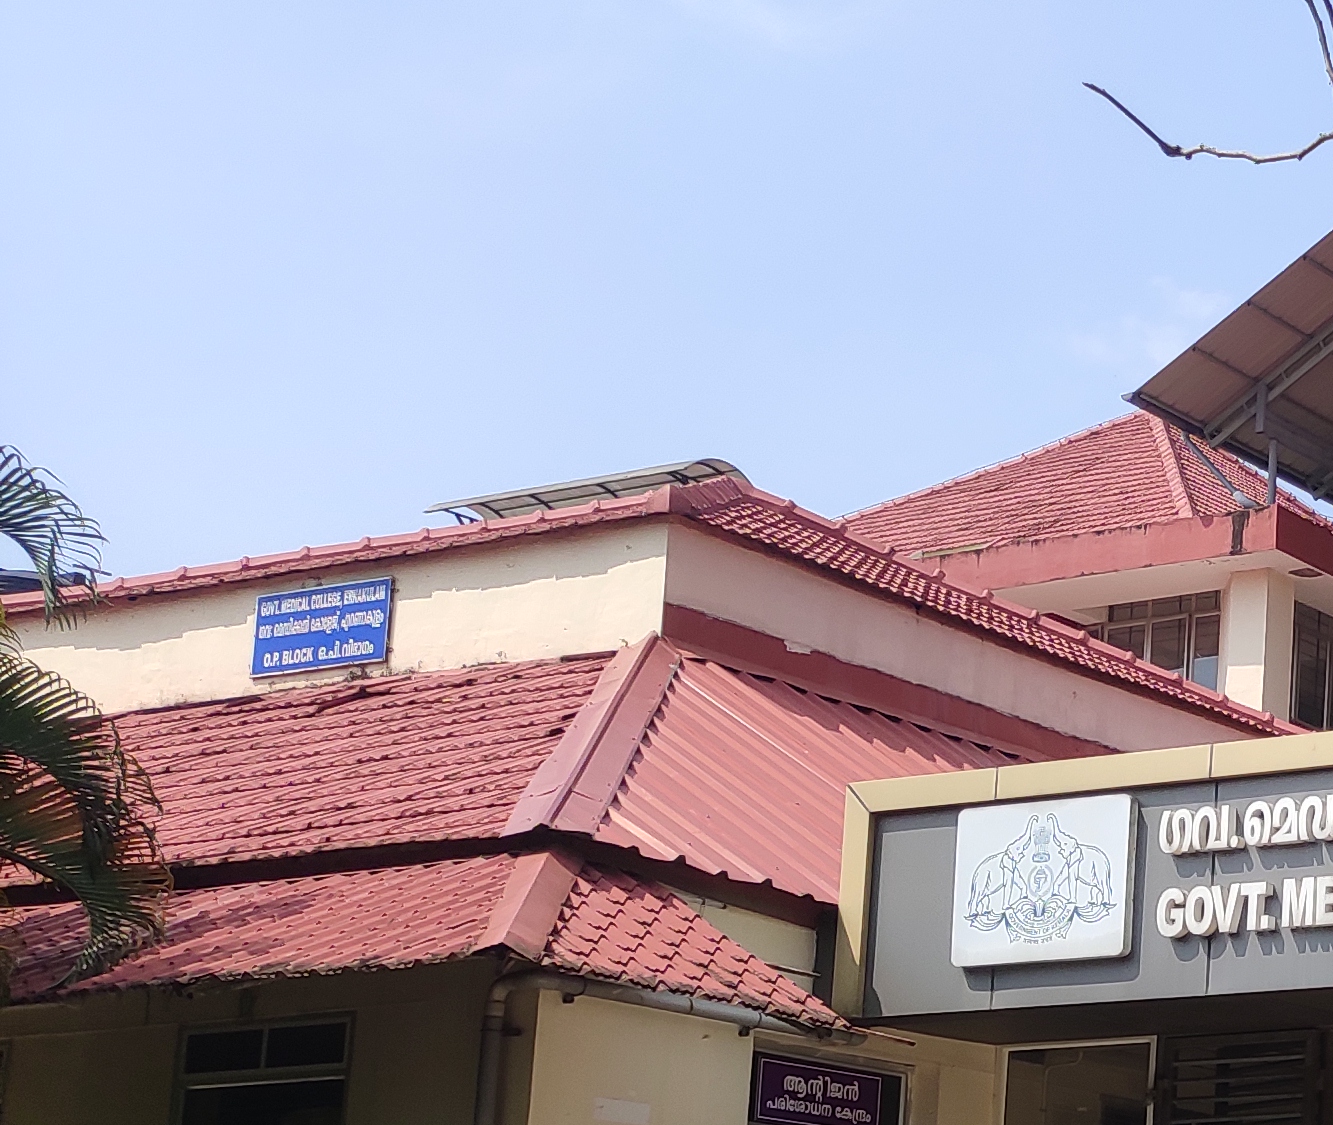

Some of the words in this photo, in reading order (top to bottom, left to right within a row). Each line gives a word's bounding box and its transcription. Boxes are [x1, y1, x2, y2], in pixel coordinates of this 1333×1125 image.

[261, 600, 280, 616] GOVT.
[281, 597, 309, 614] MEDICAL
[344, 584, 386, 605] ERNAKULAM
[263, 651, 280, 667] O.P.
[282, 646, 314, 665] BLOCK
[1156, 880, 1279, 939] GOVT.
[783, 1075, 860, 1103] ആന്റിജൻ
[766, 1094, 833, 1118] പരിശോധന
